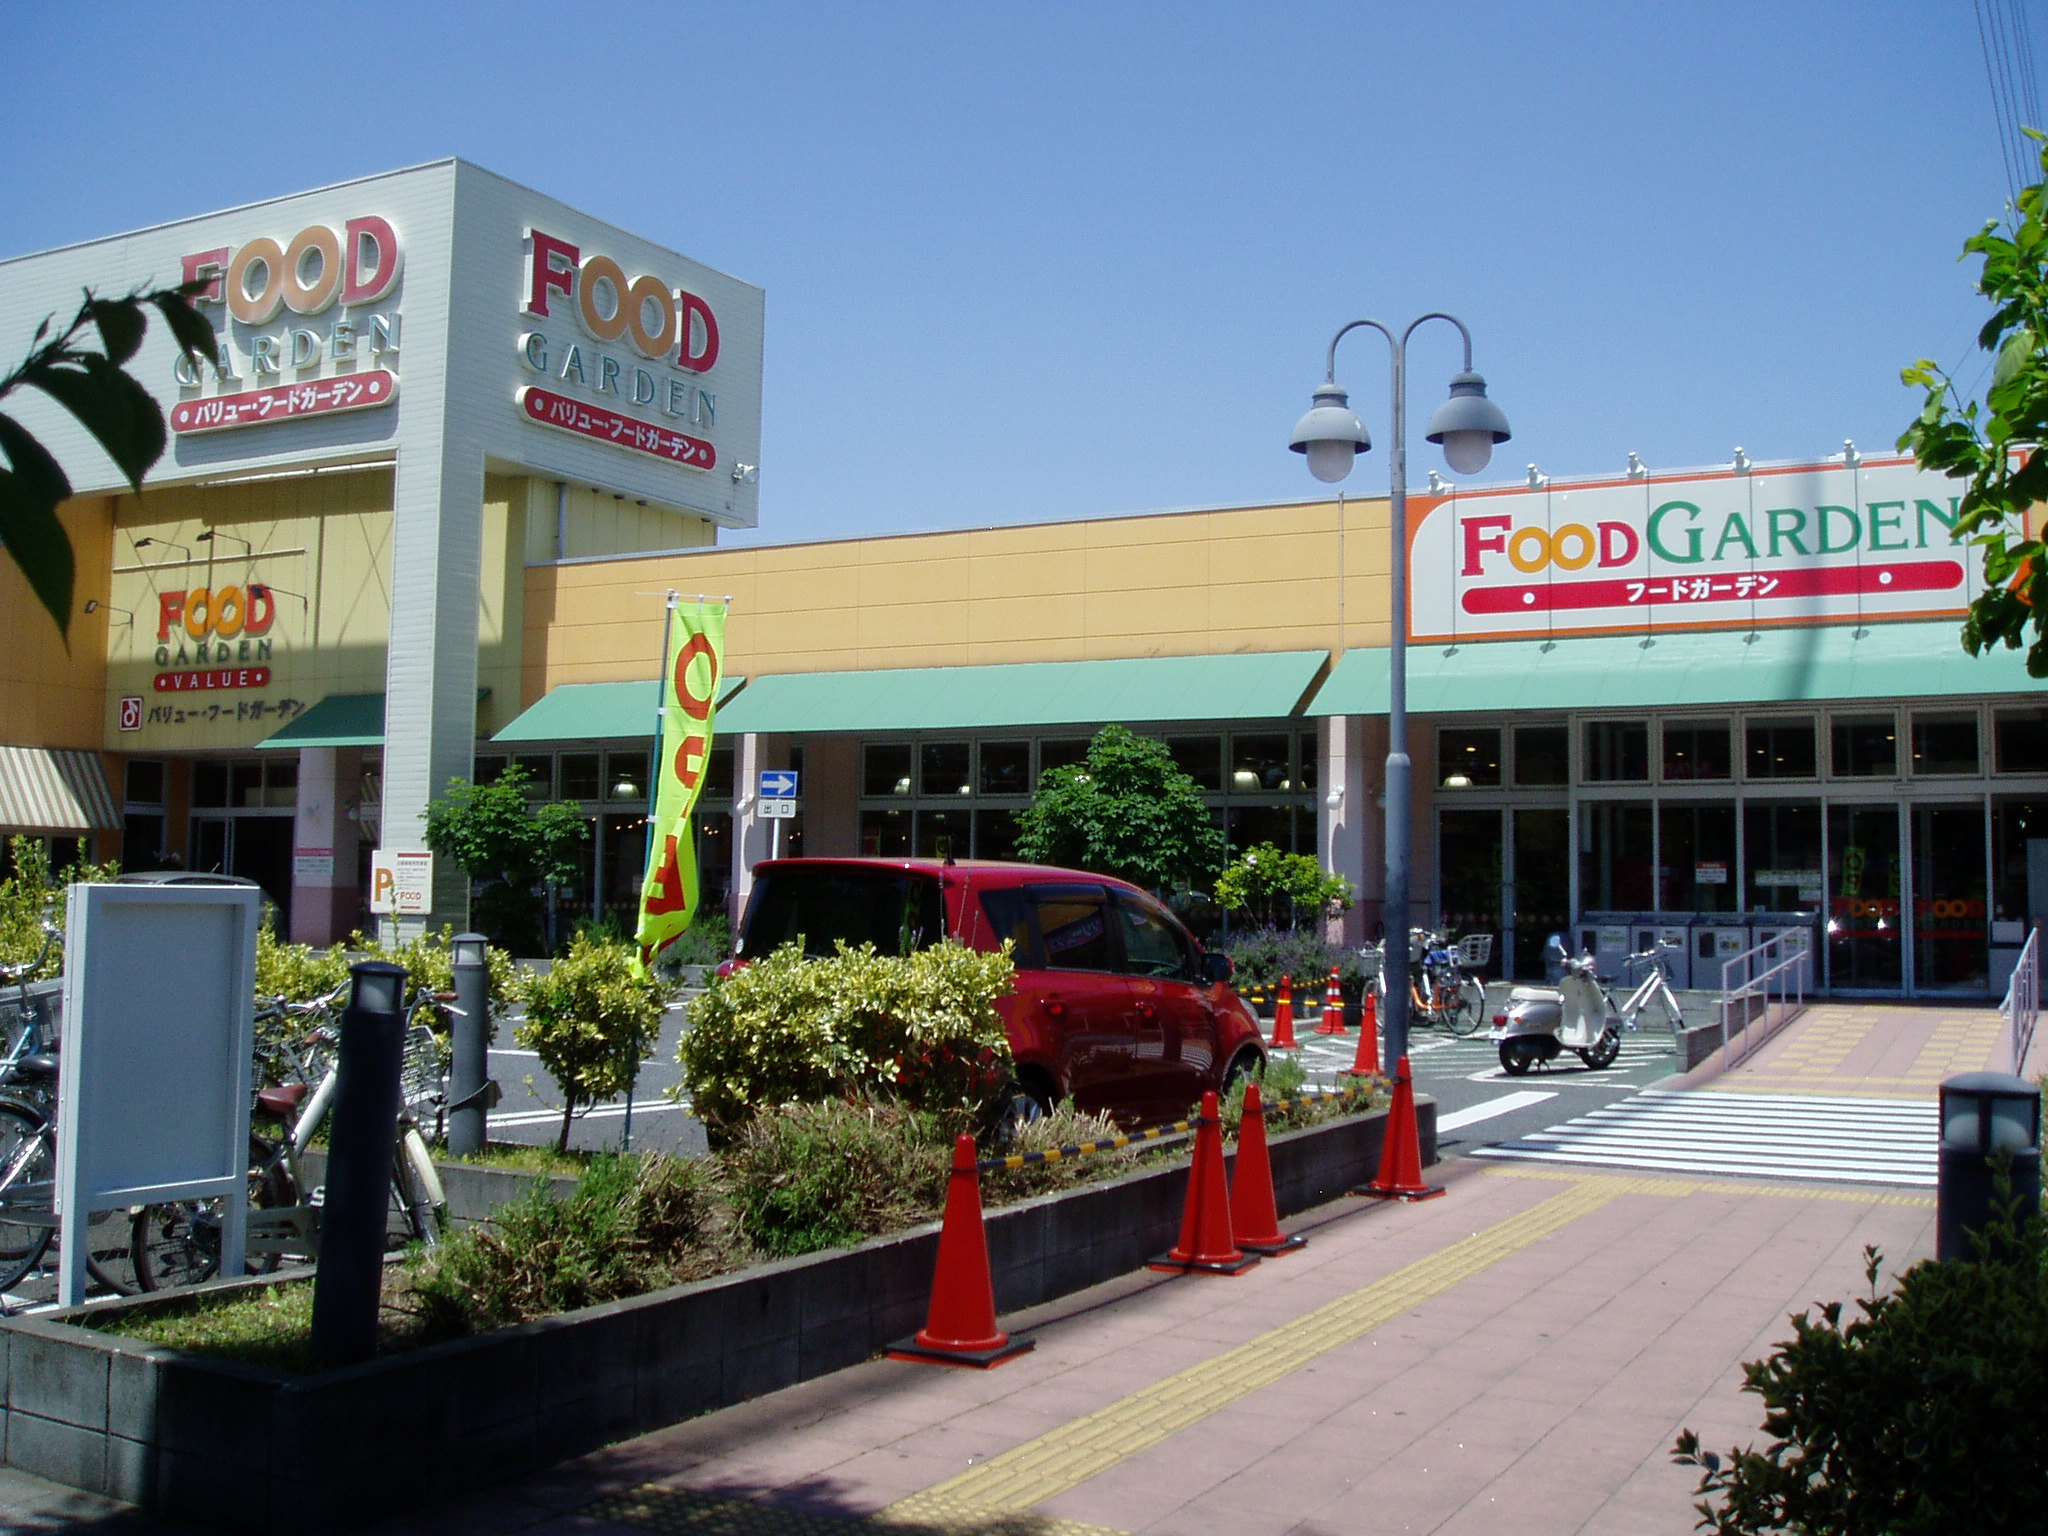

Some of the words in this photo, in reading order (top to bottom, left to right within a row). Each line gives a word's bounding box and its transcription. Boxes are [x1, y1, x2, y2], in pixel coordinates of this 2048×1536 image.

[181, 215, 399, 325] FOOD
[521, 227, 720, 373] FOOD
[173, 311, 400, 387] GARDEN
[520, 332, 717, 428] GARDEN
[1461, 514, 1640, 577] FOOD
[1647, 499, 1965, 565] GARDEN
[157, 584, 275, 639] FOOD
[1626, 576, 1780, 603] フードガーデン
[155, 639, 273, 667] GARDEN
[174, 670, 249, 689] VALUE
[375, 868, 394, 902] P
[400, 891, 422, 900] FOOD
[1916, 899, 1986, 918] FOOD
